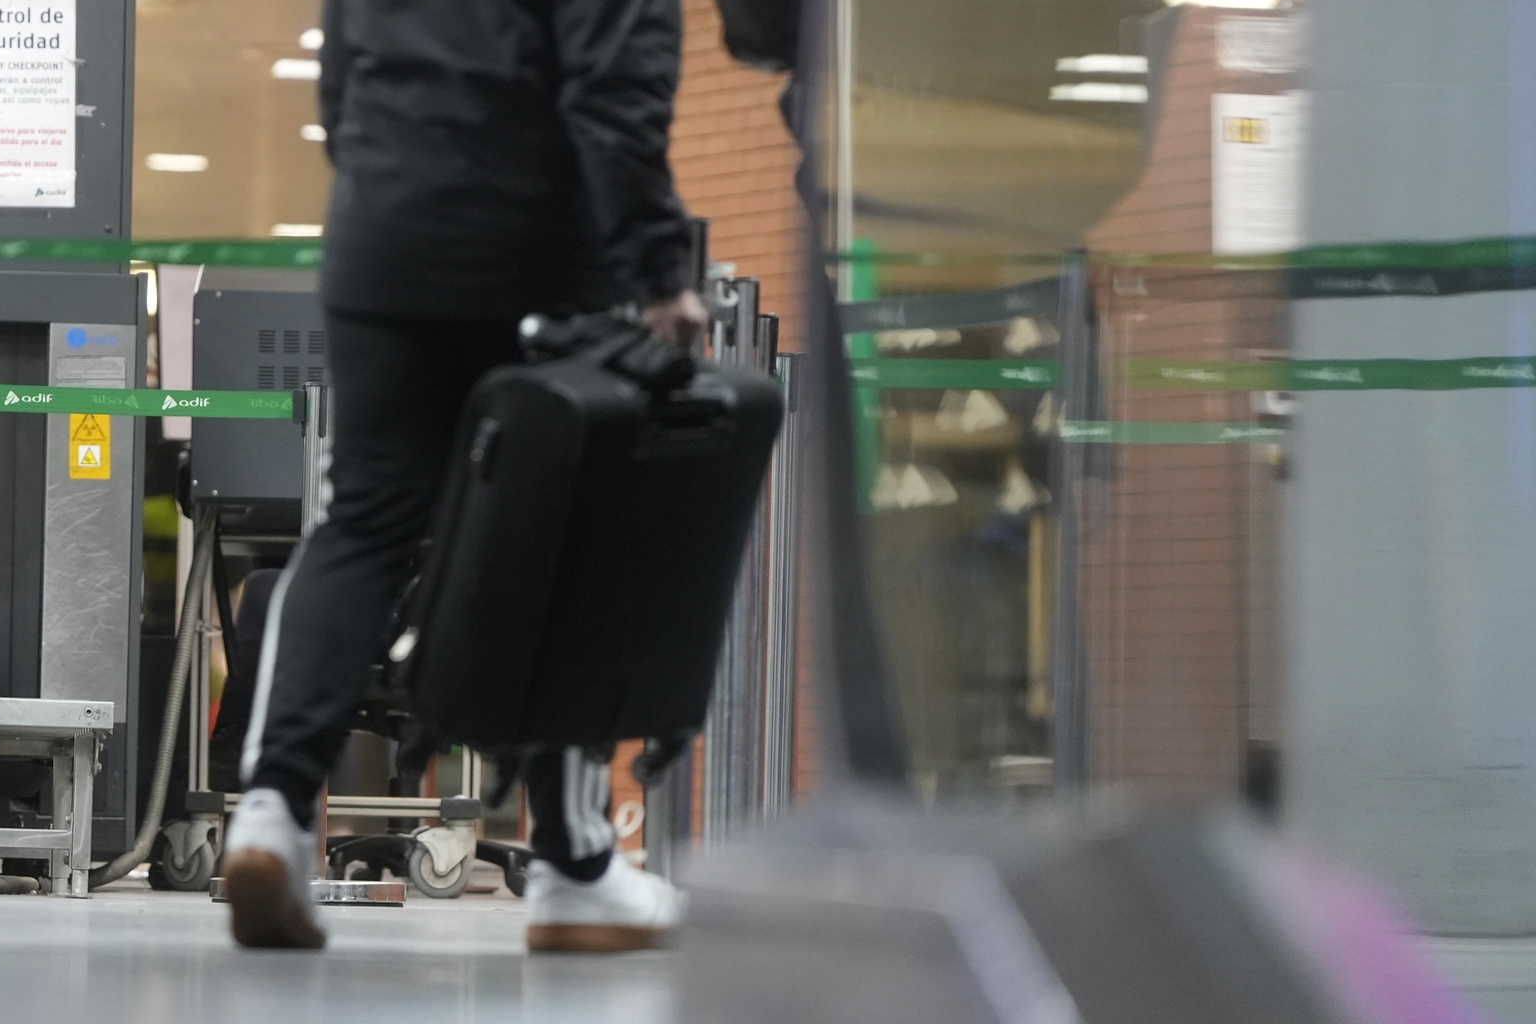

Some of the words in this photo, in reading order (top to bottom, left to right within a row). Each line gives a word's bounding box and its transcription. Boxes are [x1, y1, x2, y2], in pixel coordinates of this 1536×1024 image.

[40, 8, 64, 24] de
[8, 60, 64, 70] CHECKPOINT
[31, 76, 62, 84] control
[21, 393, 53, 404] adif
[178, 397, 210, 408] adif
